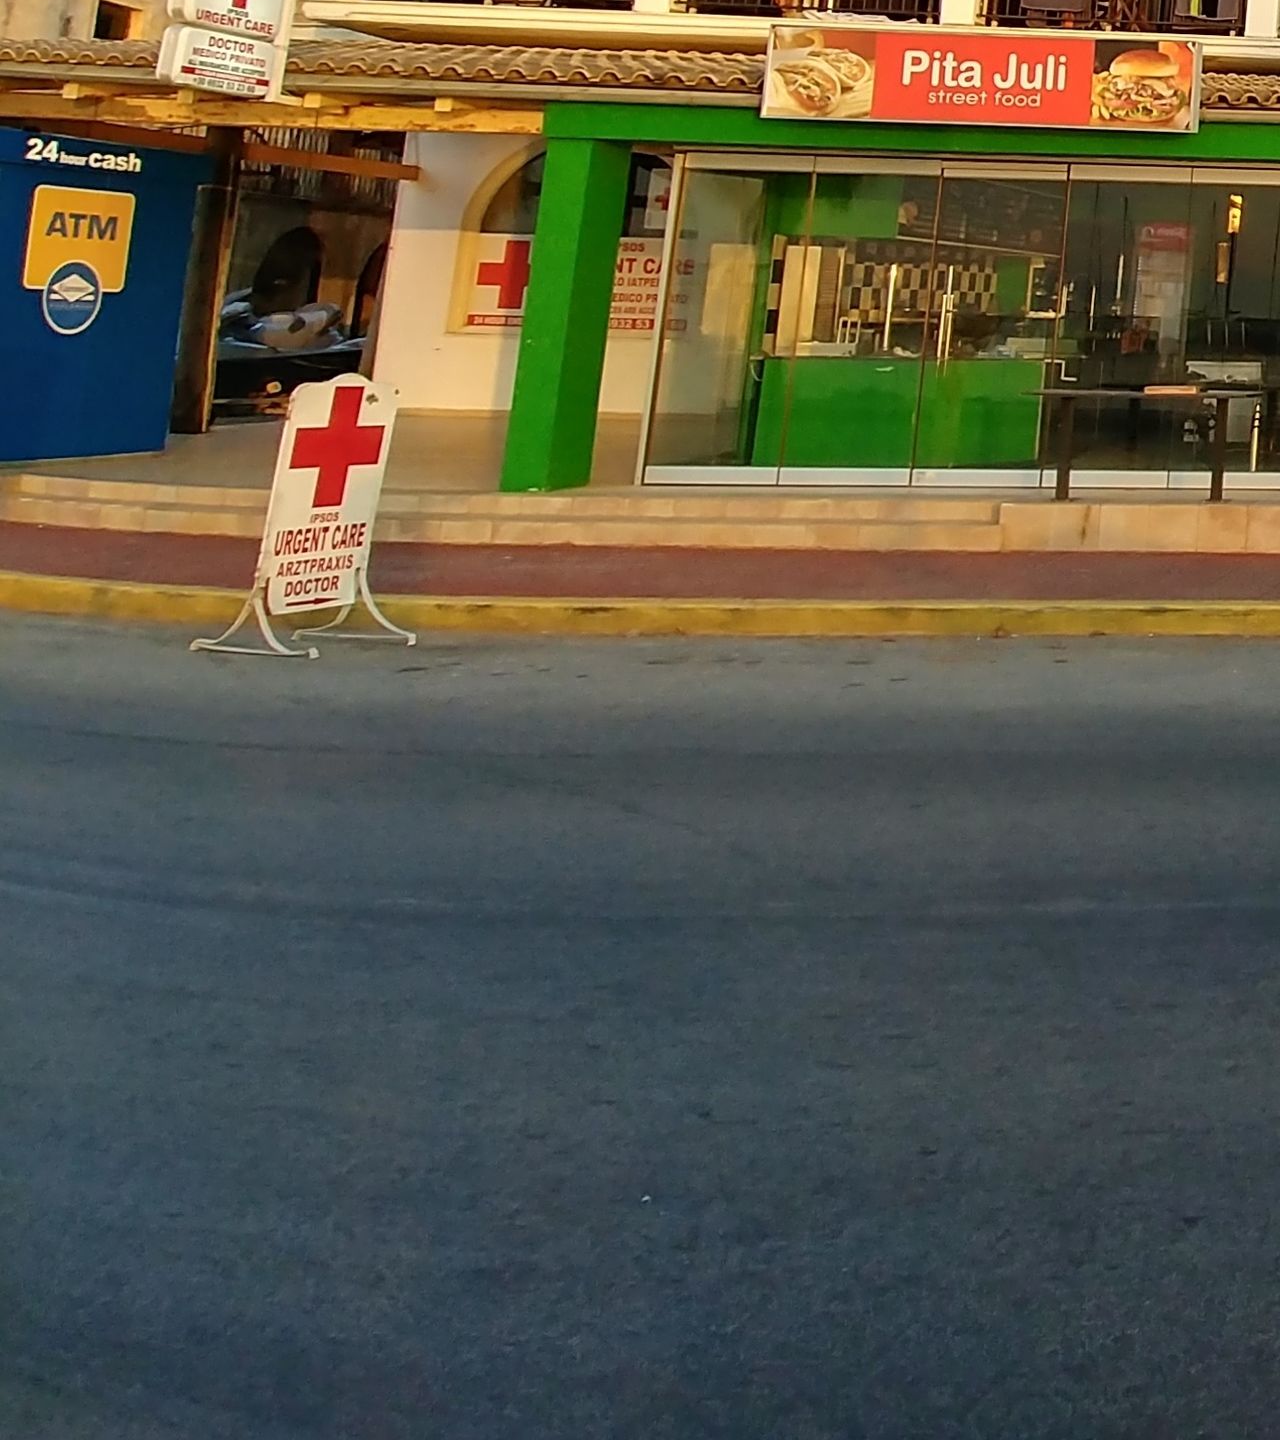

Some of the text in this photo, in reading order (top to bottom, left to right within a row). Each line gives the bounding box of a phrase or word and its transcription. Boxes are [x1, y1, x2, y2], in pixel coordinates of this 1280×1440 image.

[196, 8, 274, 35] URGENT CARE
[208, 36, 254, 54] DOCTOR
[901, 49, 1068, 91] Pita Juli
[928, 90, 1041, 107] street food
[25, 138, 59, 162] 24
[88, 152, 141, 172] cash
[45, 211, 118, 241] ATM
[612, 293, 642, 302] EDICO
[310, 512, 339, 523] IPSOS
[274, 522, 367, 556] URGENT CARE
[276, 554, 354, 577] ARZTPRAXIS
[284, 576, 339, 597] DOCTOR
